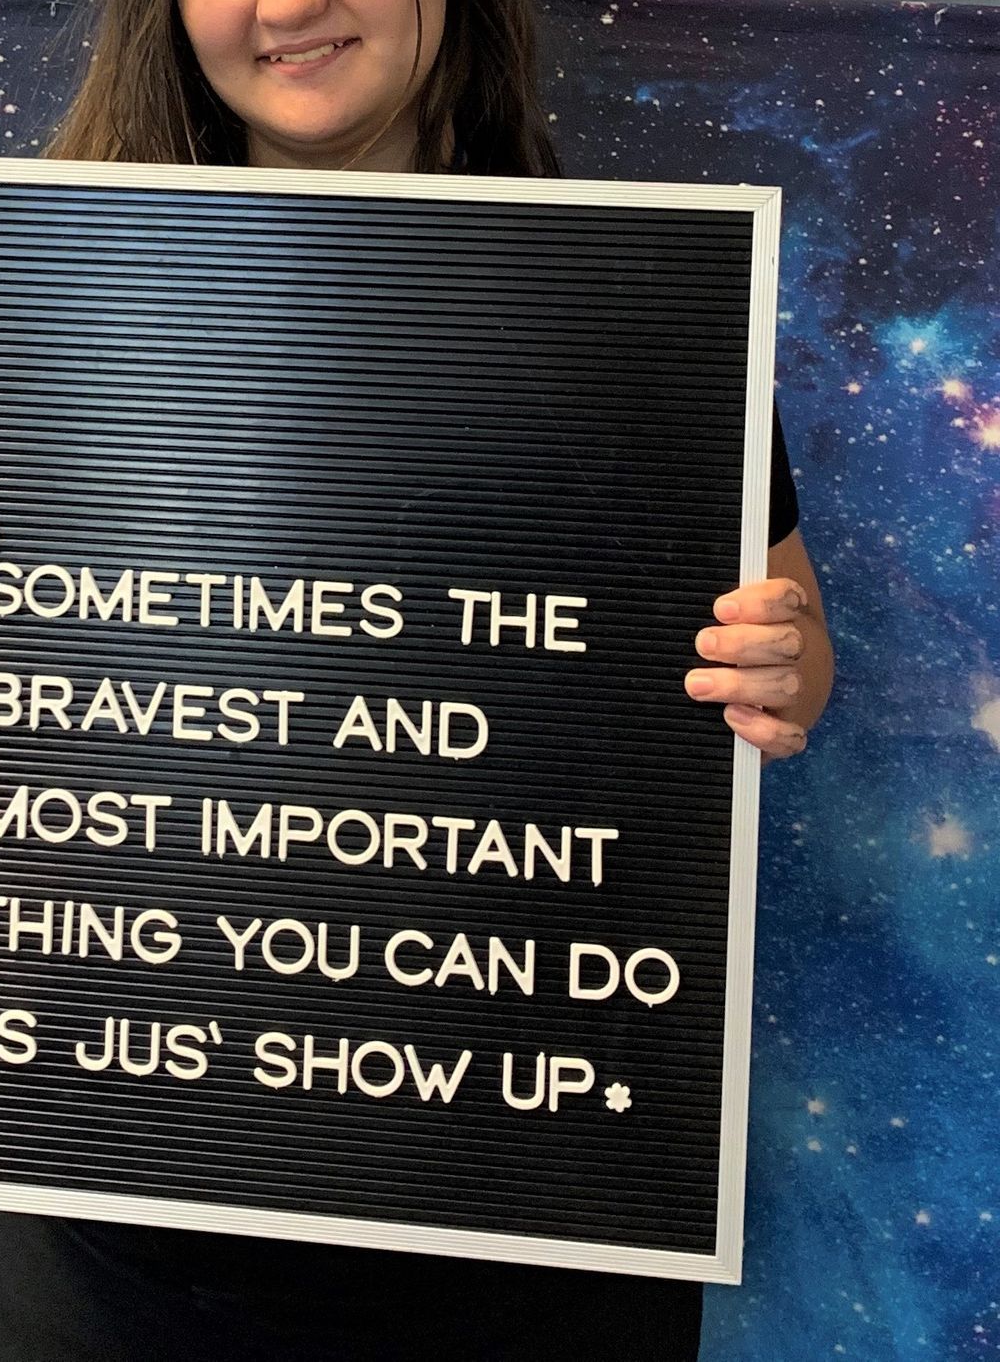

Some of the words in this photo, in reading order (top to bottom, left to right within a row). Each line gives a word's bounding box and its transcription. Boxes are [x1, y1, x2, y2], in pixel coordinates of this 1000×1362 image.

[449, 589, 587, 652] THE
[333, 696, 488, 760] AND
[202, 798, 618, 887] IMPORTANT
[217, 916, 360, 982] YOU
[385, 930, 534, 996] CAN
[570, 943, 680, 1008] DO
[254, 1032, 471, 1104] SHOW
